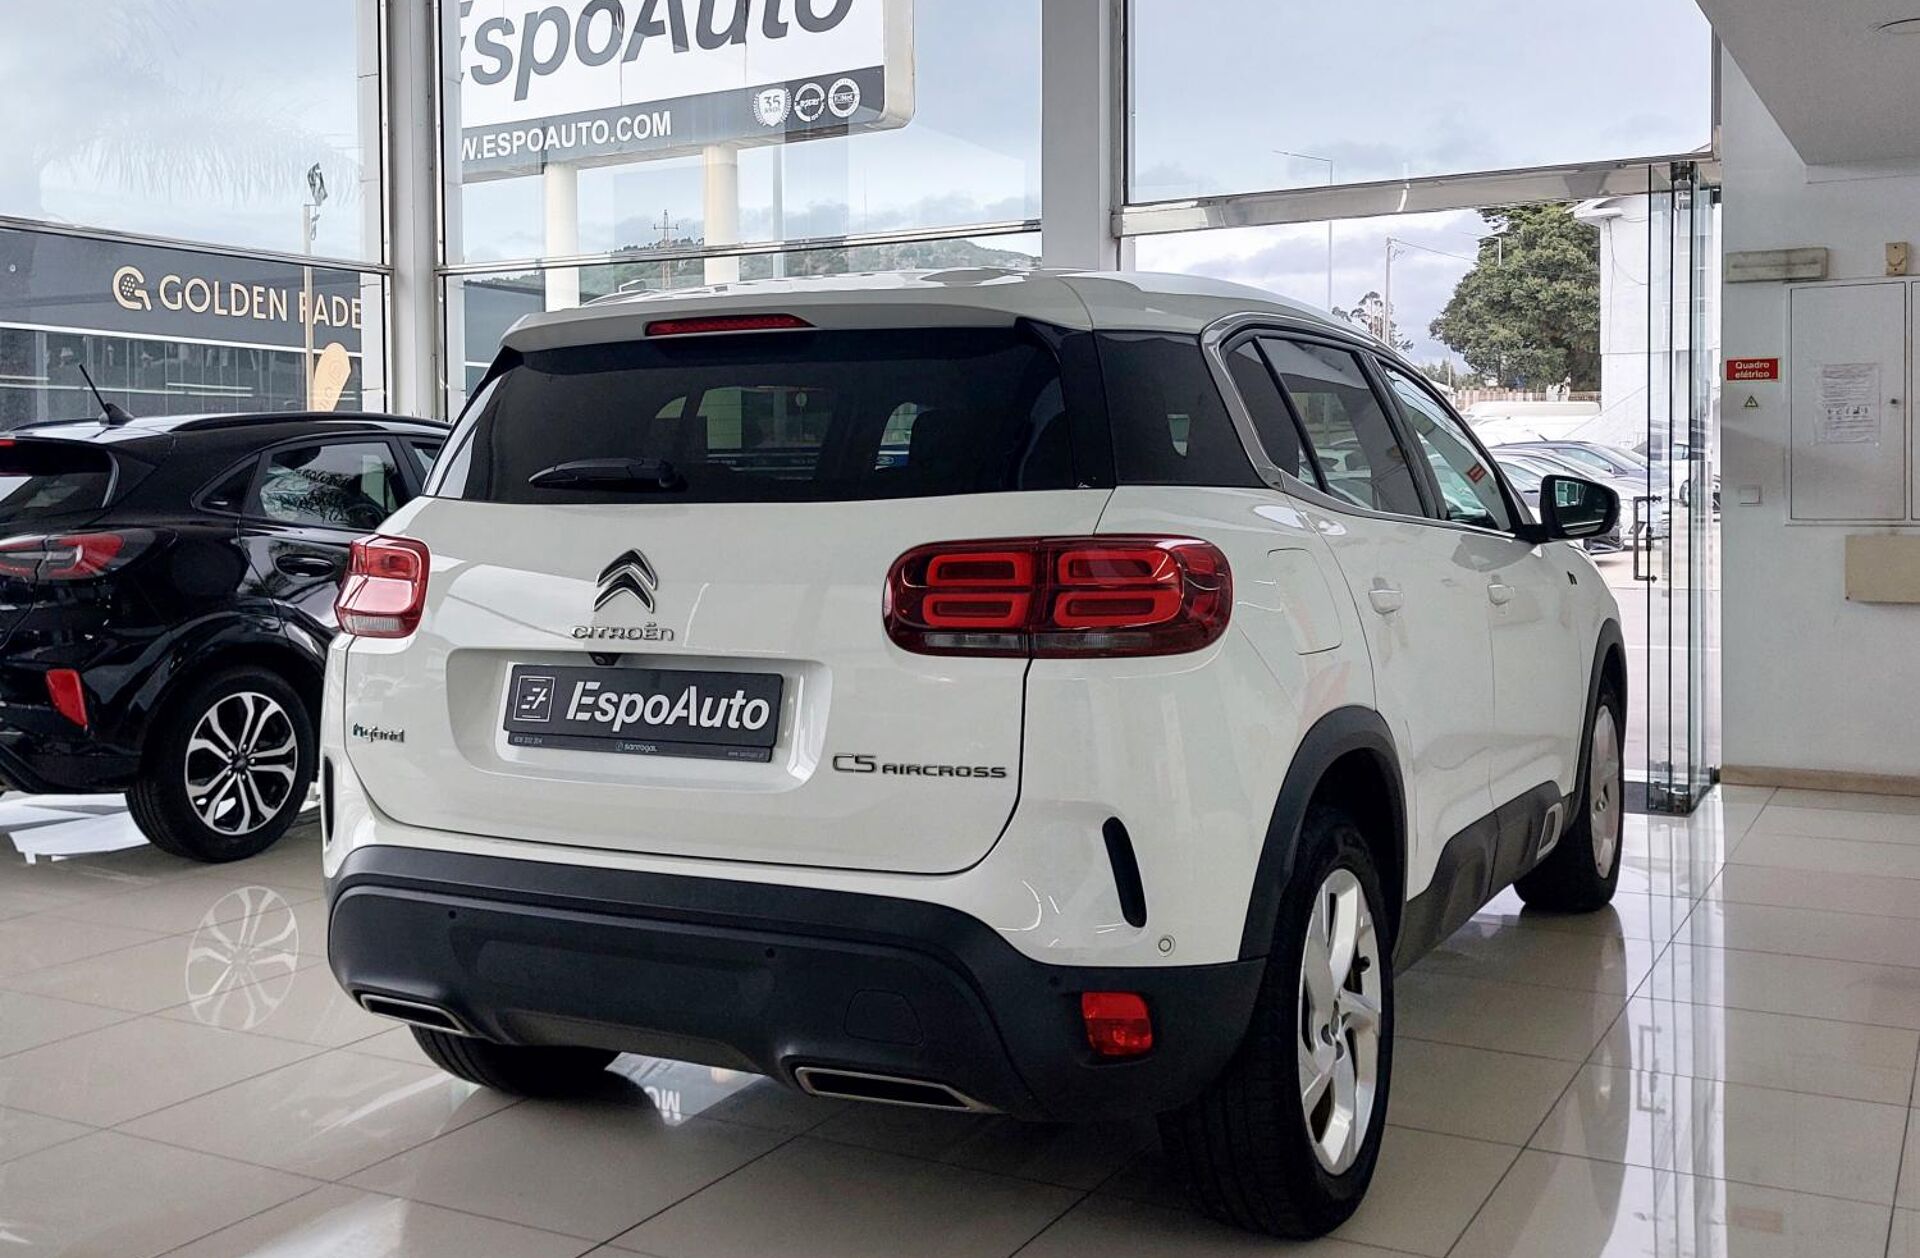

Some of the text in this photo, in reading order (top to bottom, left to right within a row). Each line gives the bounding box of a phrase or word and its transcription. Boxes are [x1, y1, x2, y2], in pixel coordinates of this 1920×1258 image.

[159, 274, 288, 322] GOLDEN
[1735, 361, 1770, 370] Quadro
[565, 680, 770, 733] EspoAuto
[832, 754, 1008, 779] C5 AIRCROSS
